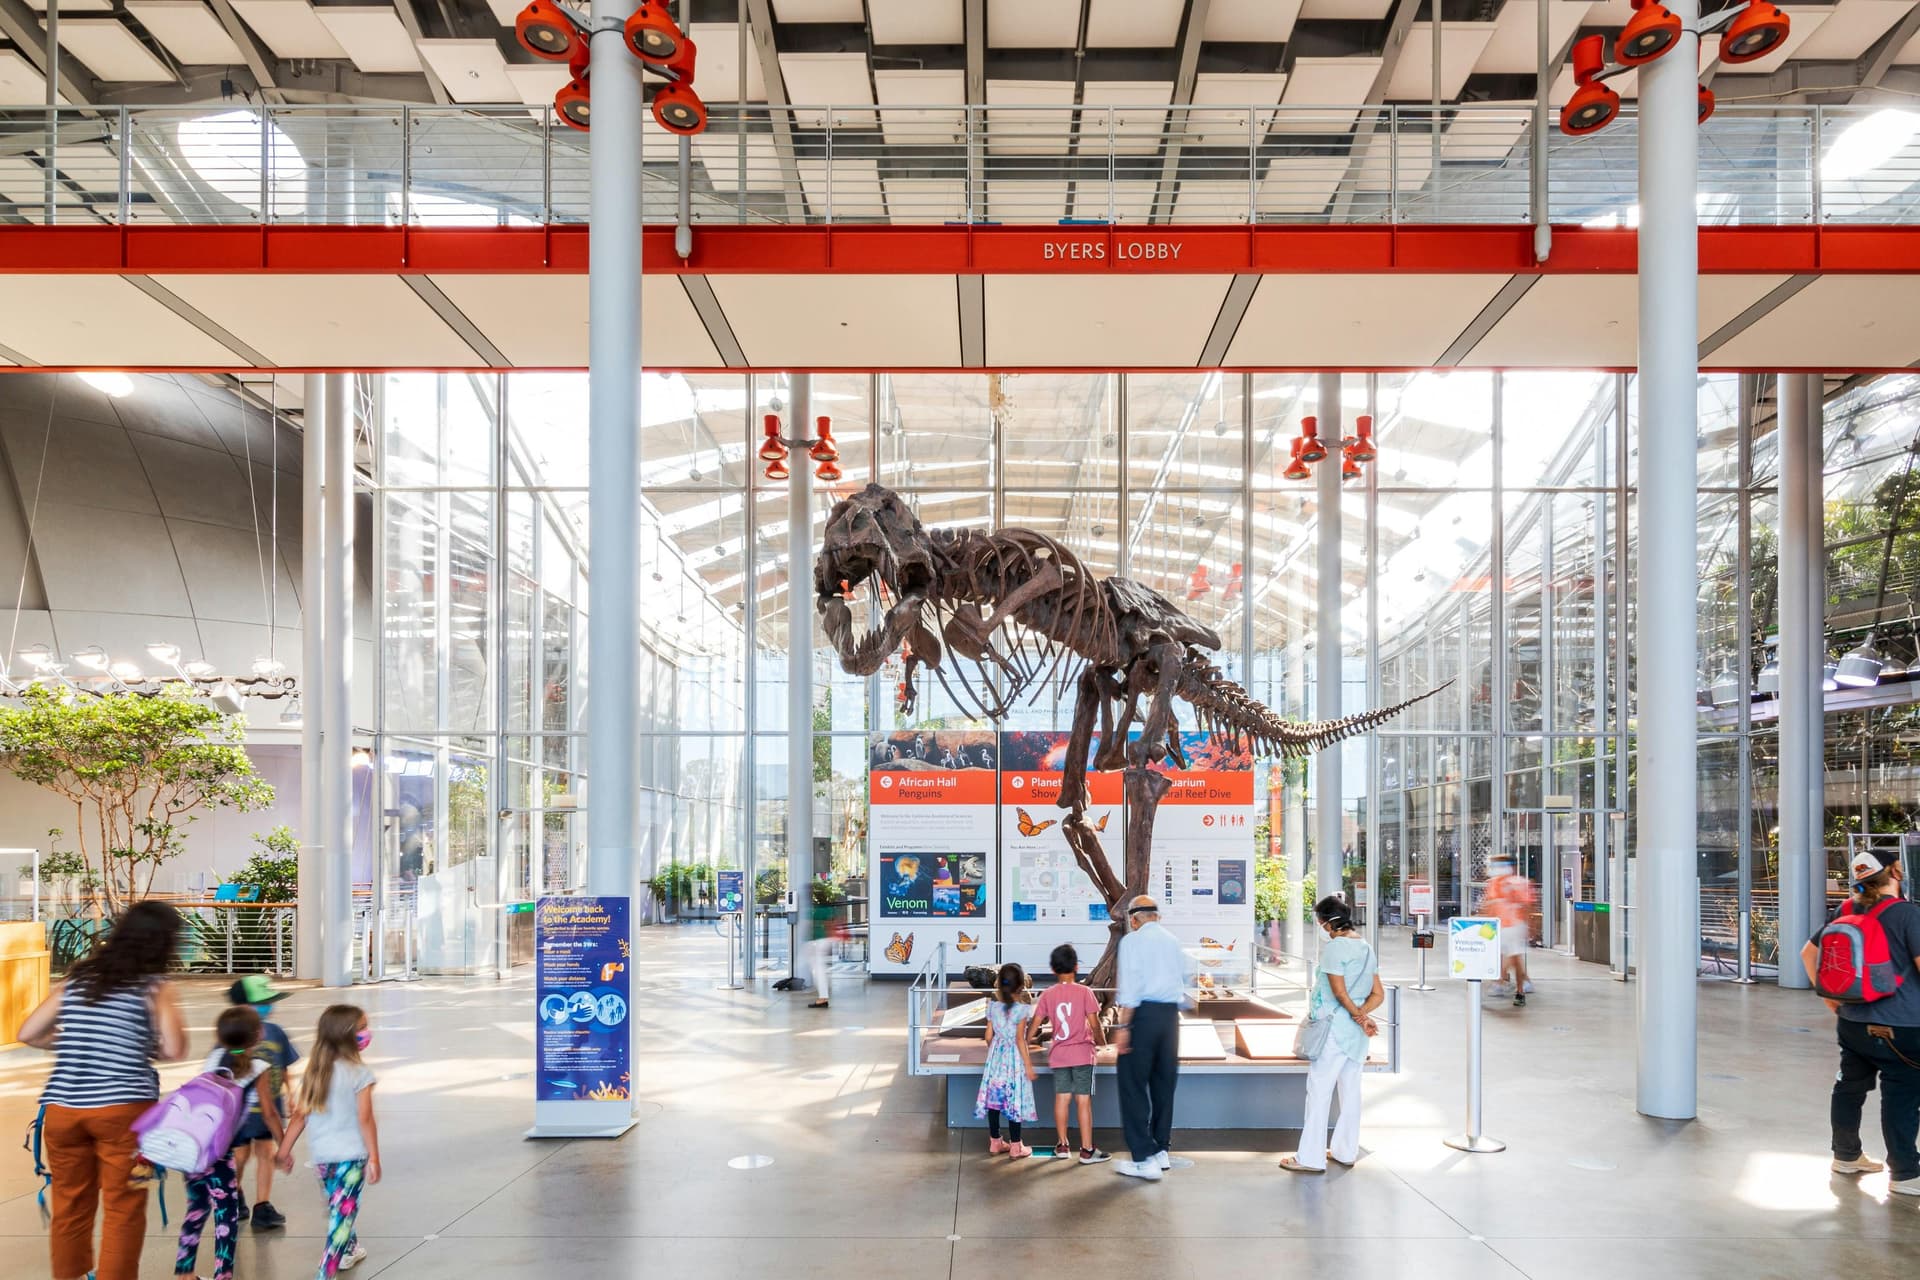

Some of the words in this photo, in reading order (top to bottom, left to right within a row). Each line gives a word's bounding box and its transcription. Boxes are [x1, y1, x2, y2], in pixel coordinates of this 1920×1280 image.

[1043, 242, 1105, 259] BYERS
[1117, 242, 1183, 259] LOBBY
[898, 776, 935, 787] African
[937, 776, 957, 787] Hall
[1171, 777, 1206, 787] uarium
[898, 789, 943, 800] Penguins
[1031, 788, 1057, 798] Show
[1185, 788, 1207, 798] Reef
[1209, 788, 1232, 798] Dive
[886, 896, 928, 909] Venom
[544, 905, 582, 914] Welcome
[584, 905, 604, 914] back
[543, 915, 552, 923] to
[554, 915, 568, 923] the
[568, 914, 611, 925] Academy!
[1055, 1001, 1072, 1041] S
